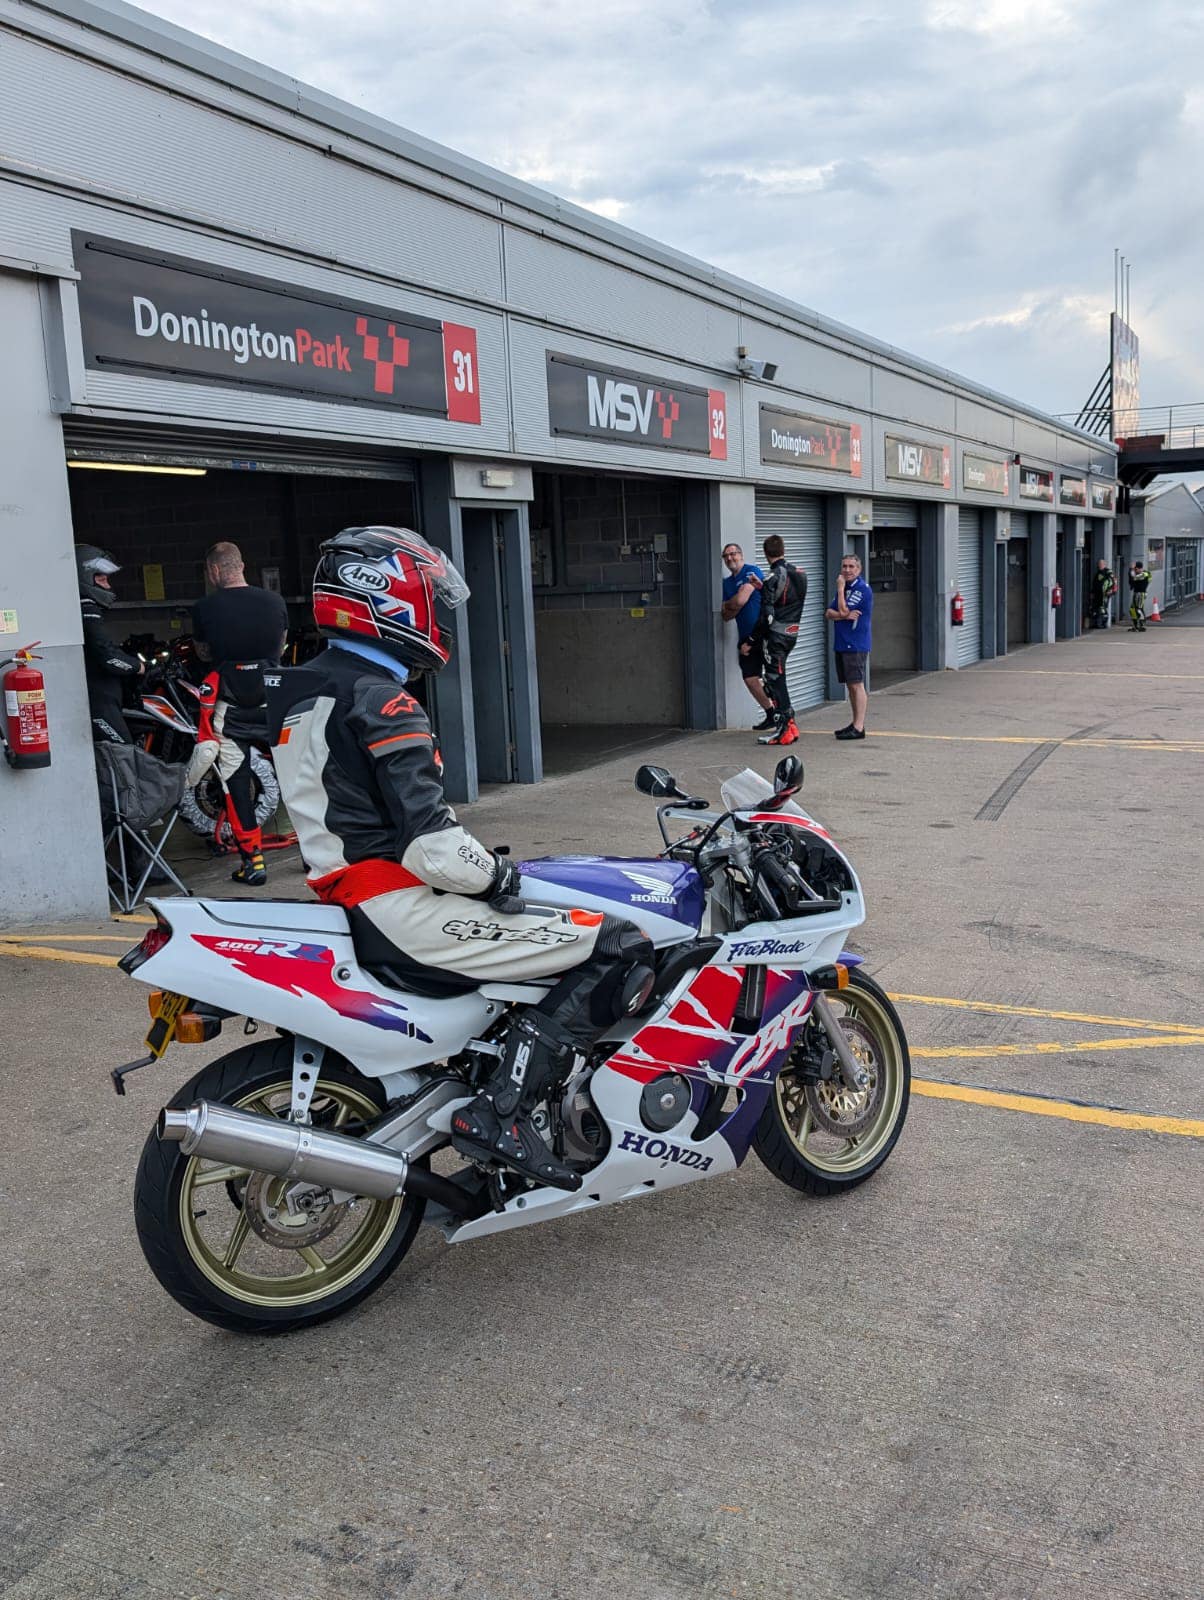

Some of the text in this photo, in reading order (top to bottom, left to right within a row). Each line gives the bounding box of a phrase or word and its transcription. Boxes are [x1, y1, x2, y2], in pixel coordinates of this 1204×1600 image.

[453, 350, 473, 394] 31
[587, 376, 654, 435] MSV
[712, 409, 725, 440] 32
[898, 444, 923, 477] MSV
[341, 566, 385, 587] Arai
[630, 893, 678, 905] HONDA
[617, 1130, 714, 1171] HONDA
